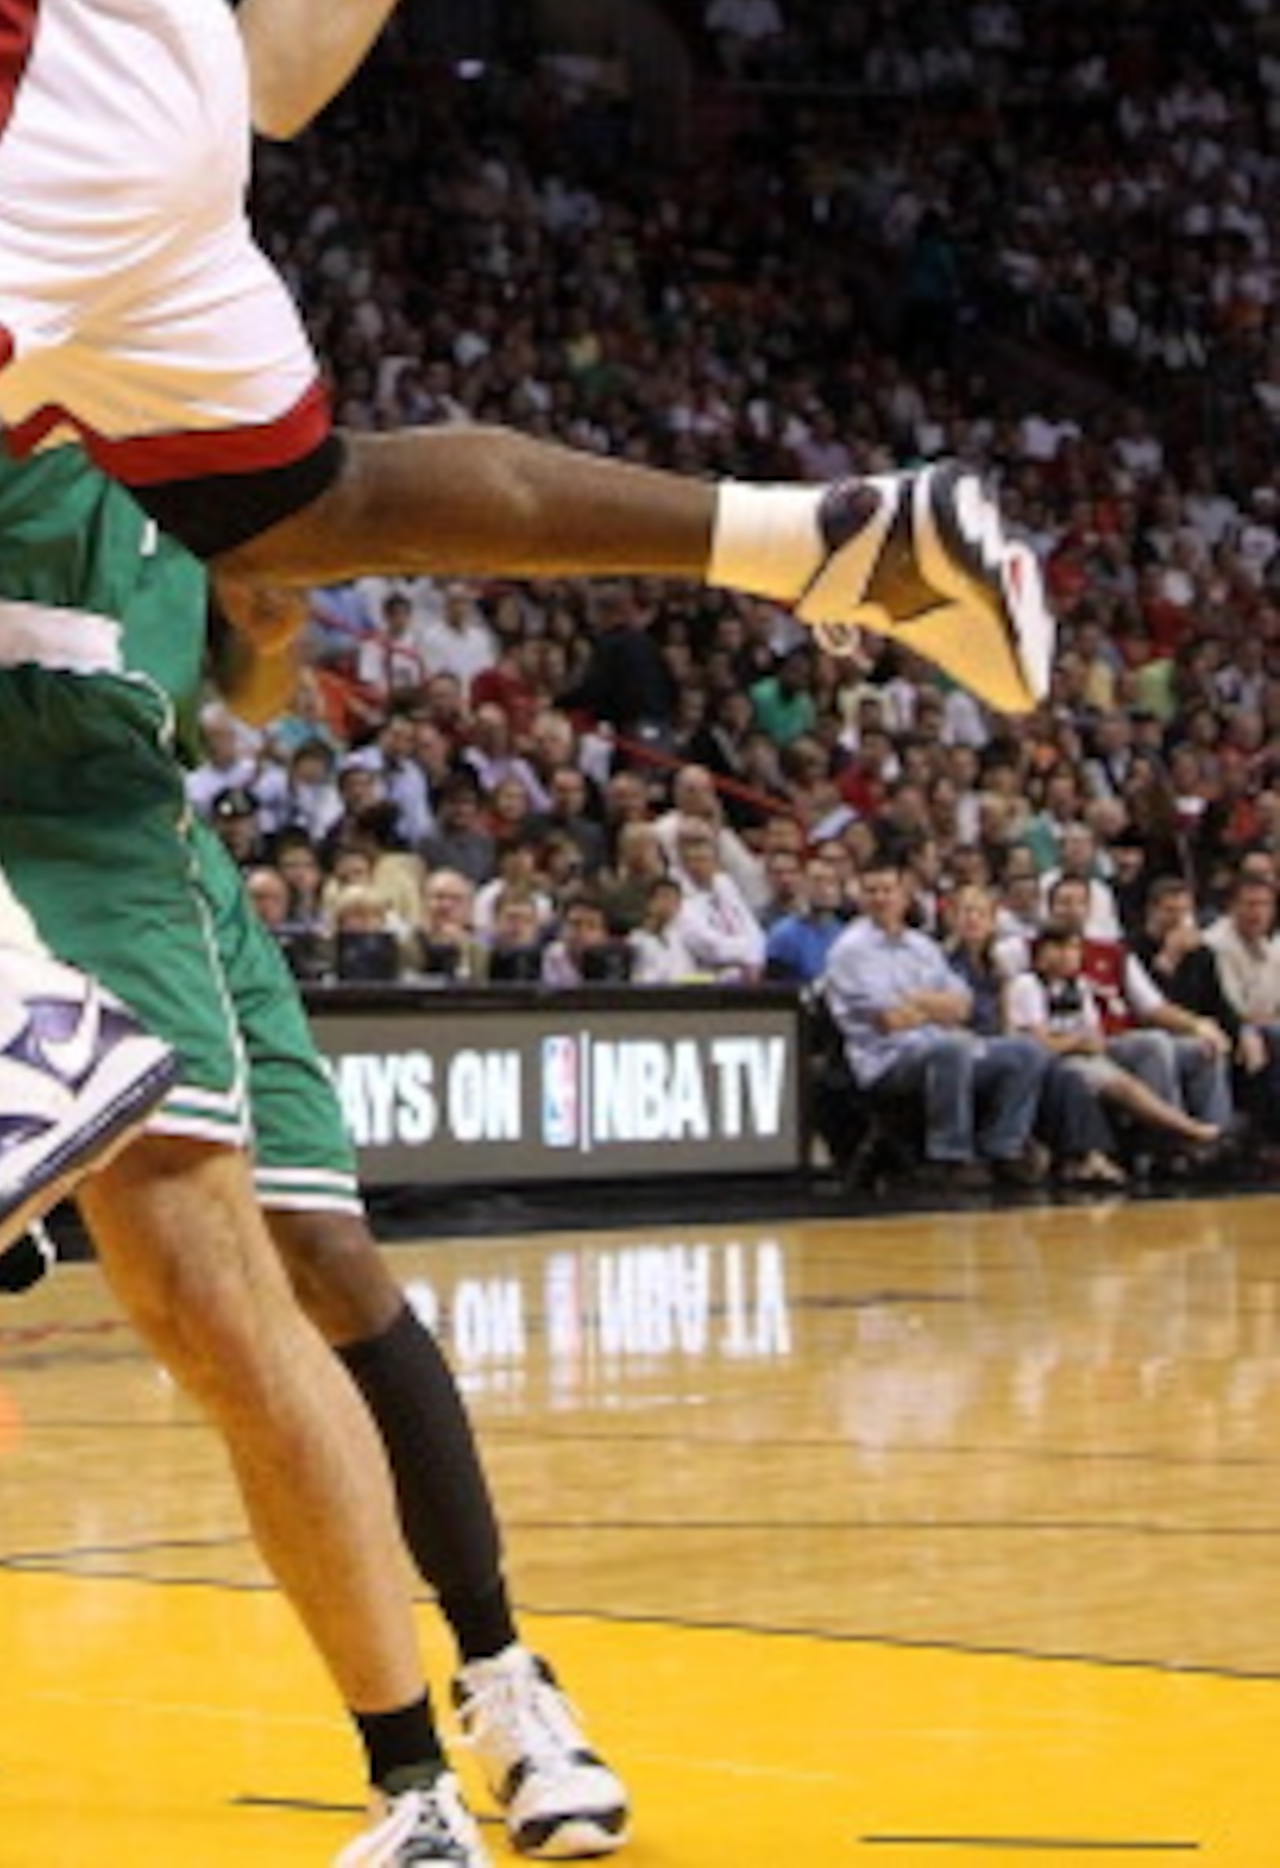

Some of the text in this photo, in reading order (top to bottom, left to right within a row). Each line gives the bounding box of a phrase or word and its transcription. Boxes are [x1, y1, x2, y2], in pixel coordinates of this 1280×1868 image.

[322, 1036, 786, 1147] AYS ON NBA TV
